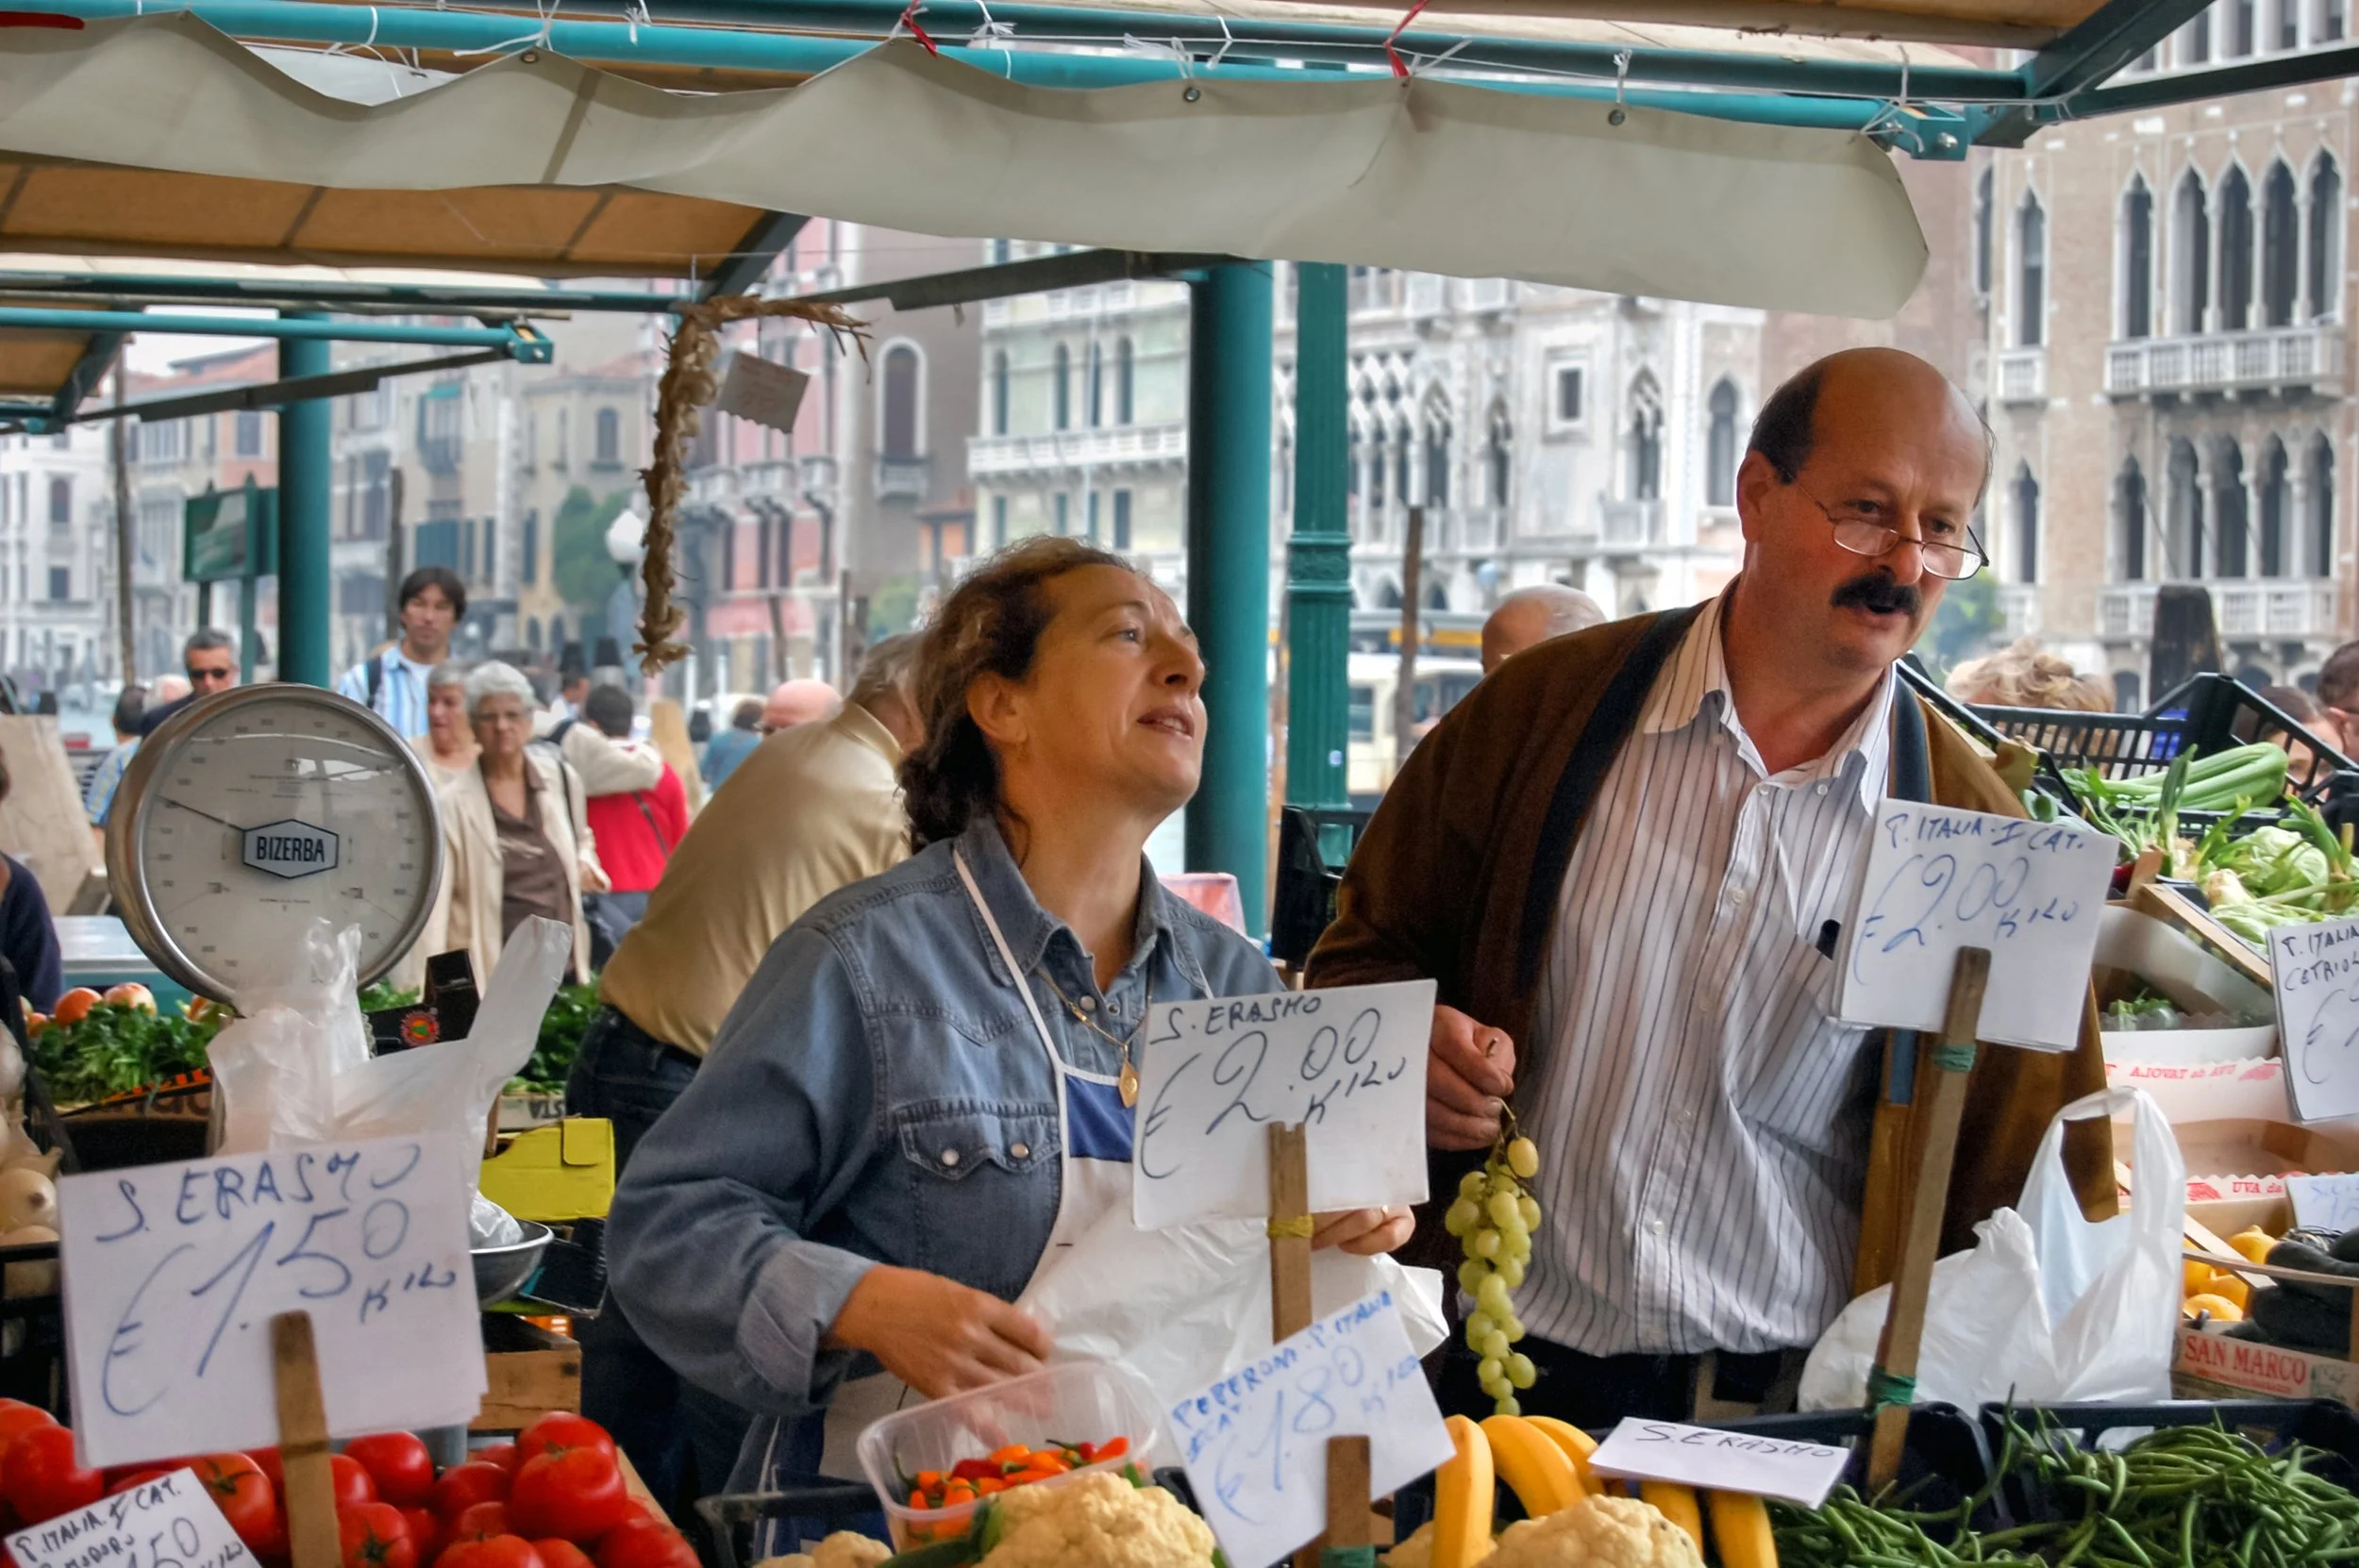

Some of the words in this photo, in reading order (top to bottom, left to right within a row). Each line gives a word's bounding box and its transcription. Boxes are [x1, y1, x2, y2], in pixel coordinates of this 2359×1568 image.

[256, 835, 326, 863] BIZERBA
[1206, 995, 1322, 1036] ERASMO
[2232, 1180, 2262, 1193] UVA
[2184, 1334, 2227, 1366] SAN
[2234, 1344, 2308, 1385] MARCO
